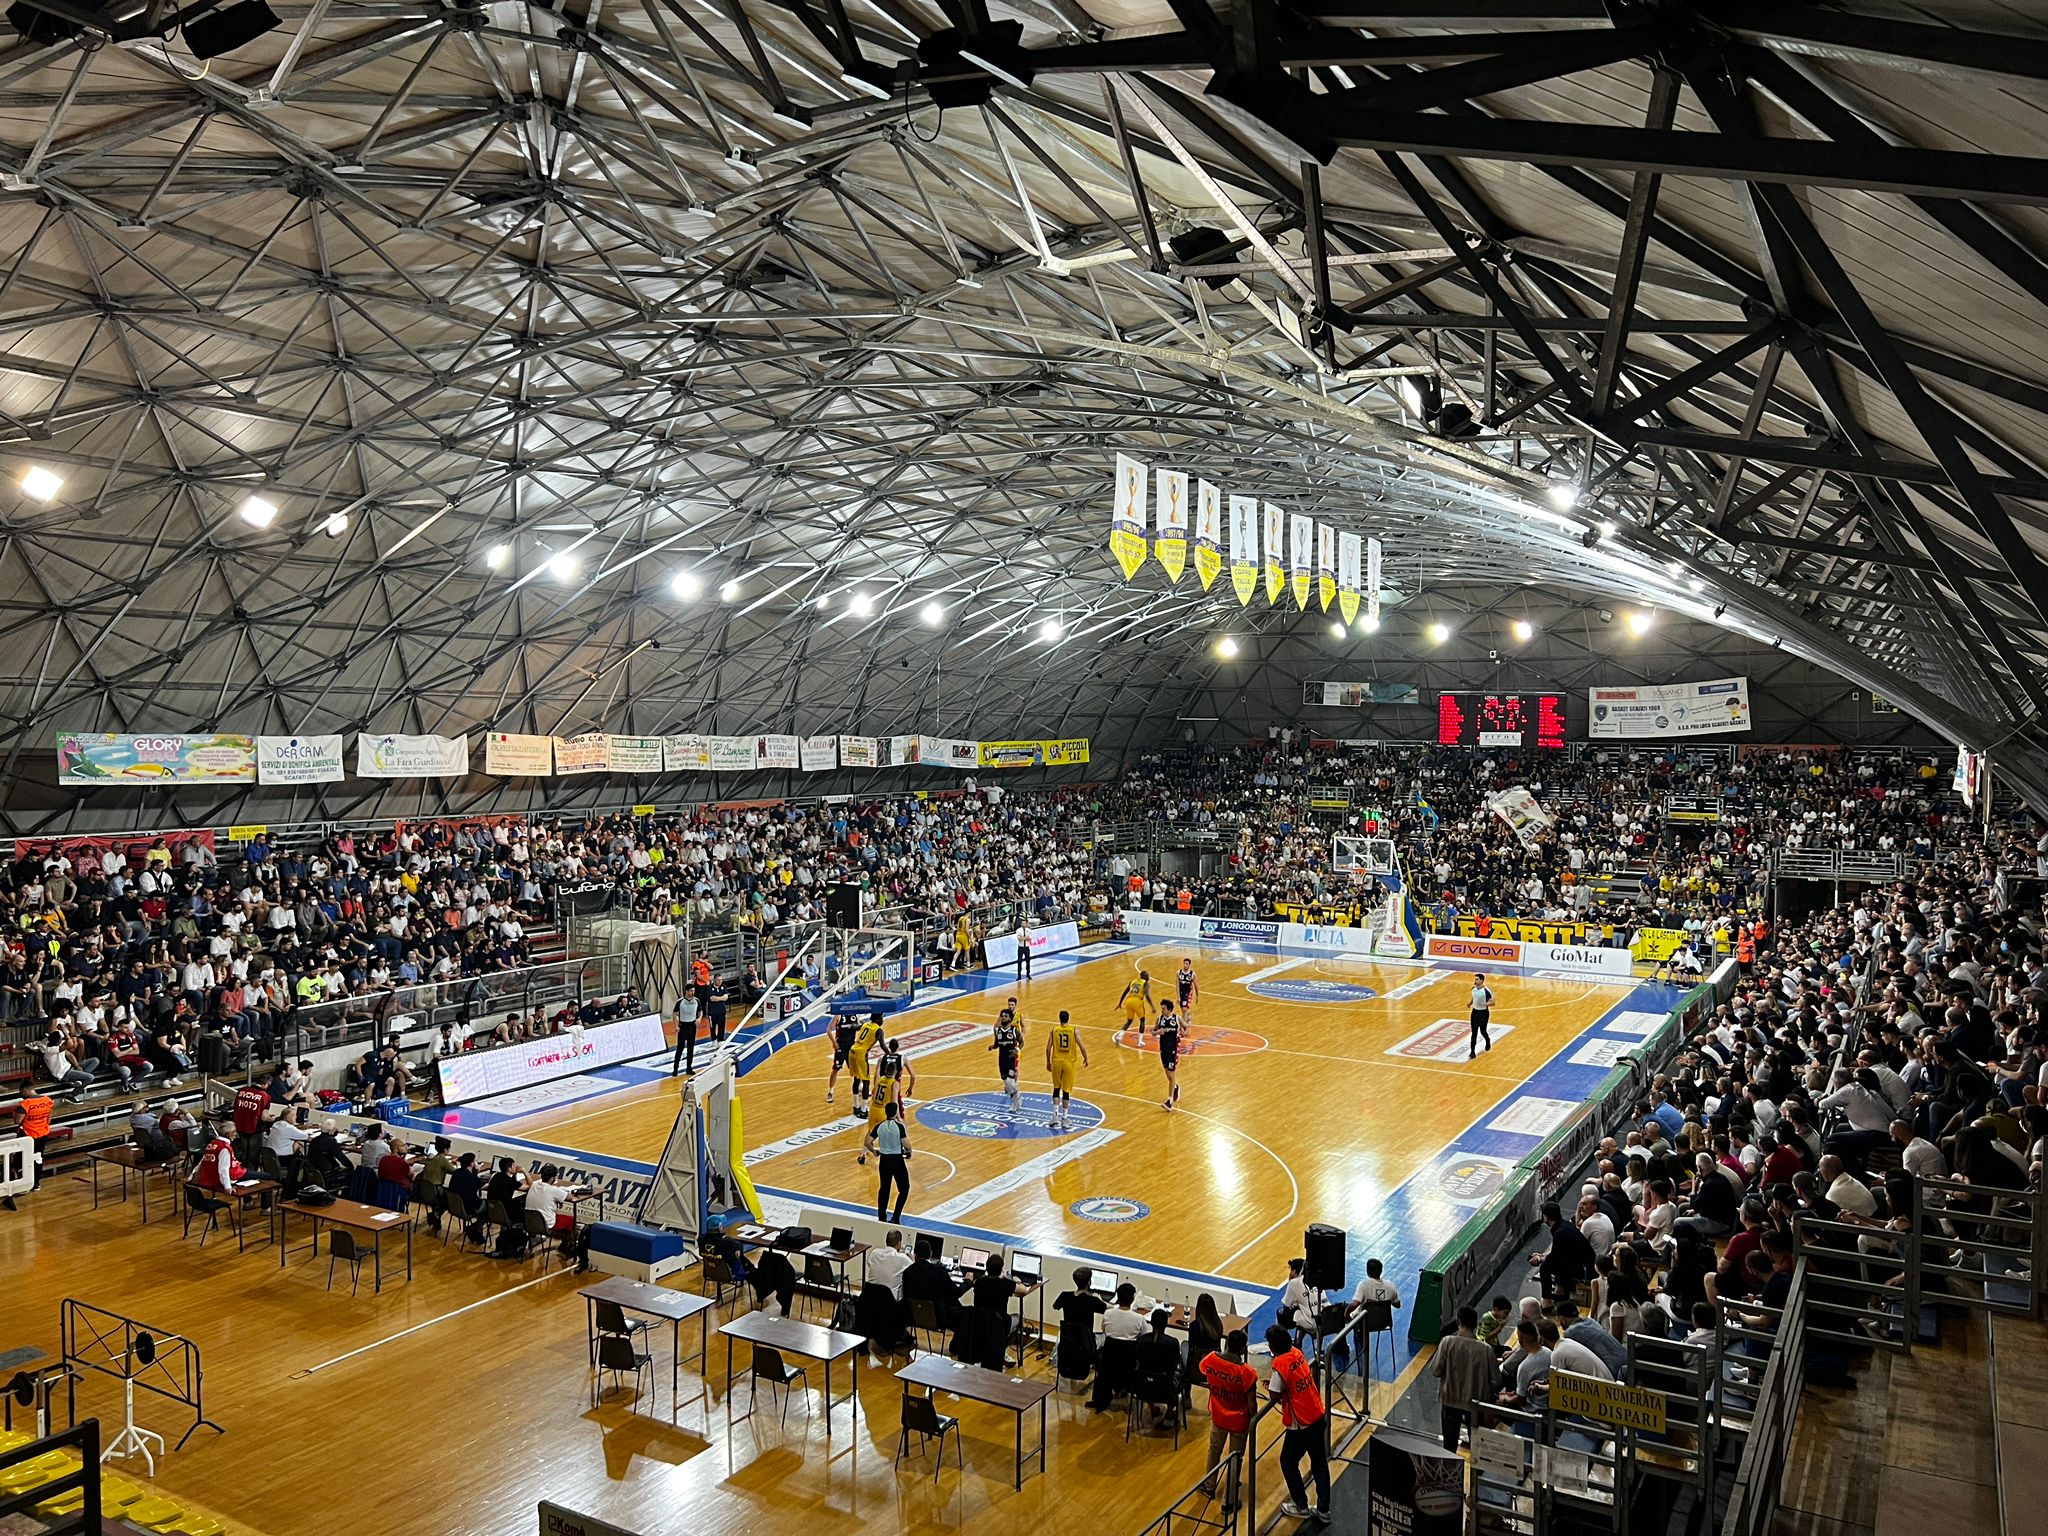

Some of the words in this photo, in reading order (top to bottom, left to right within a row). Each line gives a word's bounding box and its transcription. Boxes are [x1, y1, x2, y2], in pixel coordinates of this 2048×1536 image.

[134, 738, 183, 751] GLORY
[1061, 741, 1088, 752] PICCOLI
[261, 761, 280, 769] SERVIZI
[281, 761, 288, 769] DI
[558, 879, 616, 896] tufano
[1221, 921, 1276, 933] LONGOBARDI
[1450, 944, 1514, 957] GIVOVA
[1550, 948, 1604, 964] GioMat
[860, 1027, 869, 1040] 0
[1059, 1034, 1069, 1048] 13
[876, 1084, 887, 1101] 15
[1555, 1375, 1600, 1398] TRIBUNA
[1605, 1386, 1663, 1411] NUMERATA
[1561, 1394, 1590, 1413] SUD
[1598, 1403, 1658, 1429] DISPARI
[1372, 1499, 1413, 1527] partita
